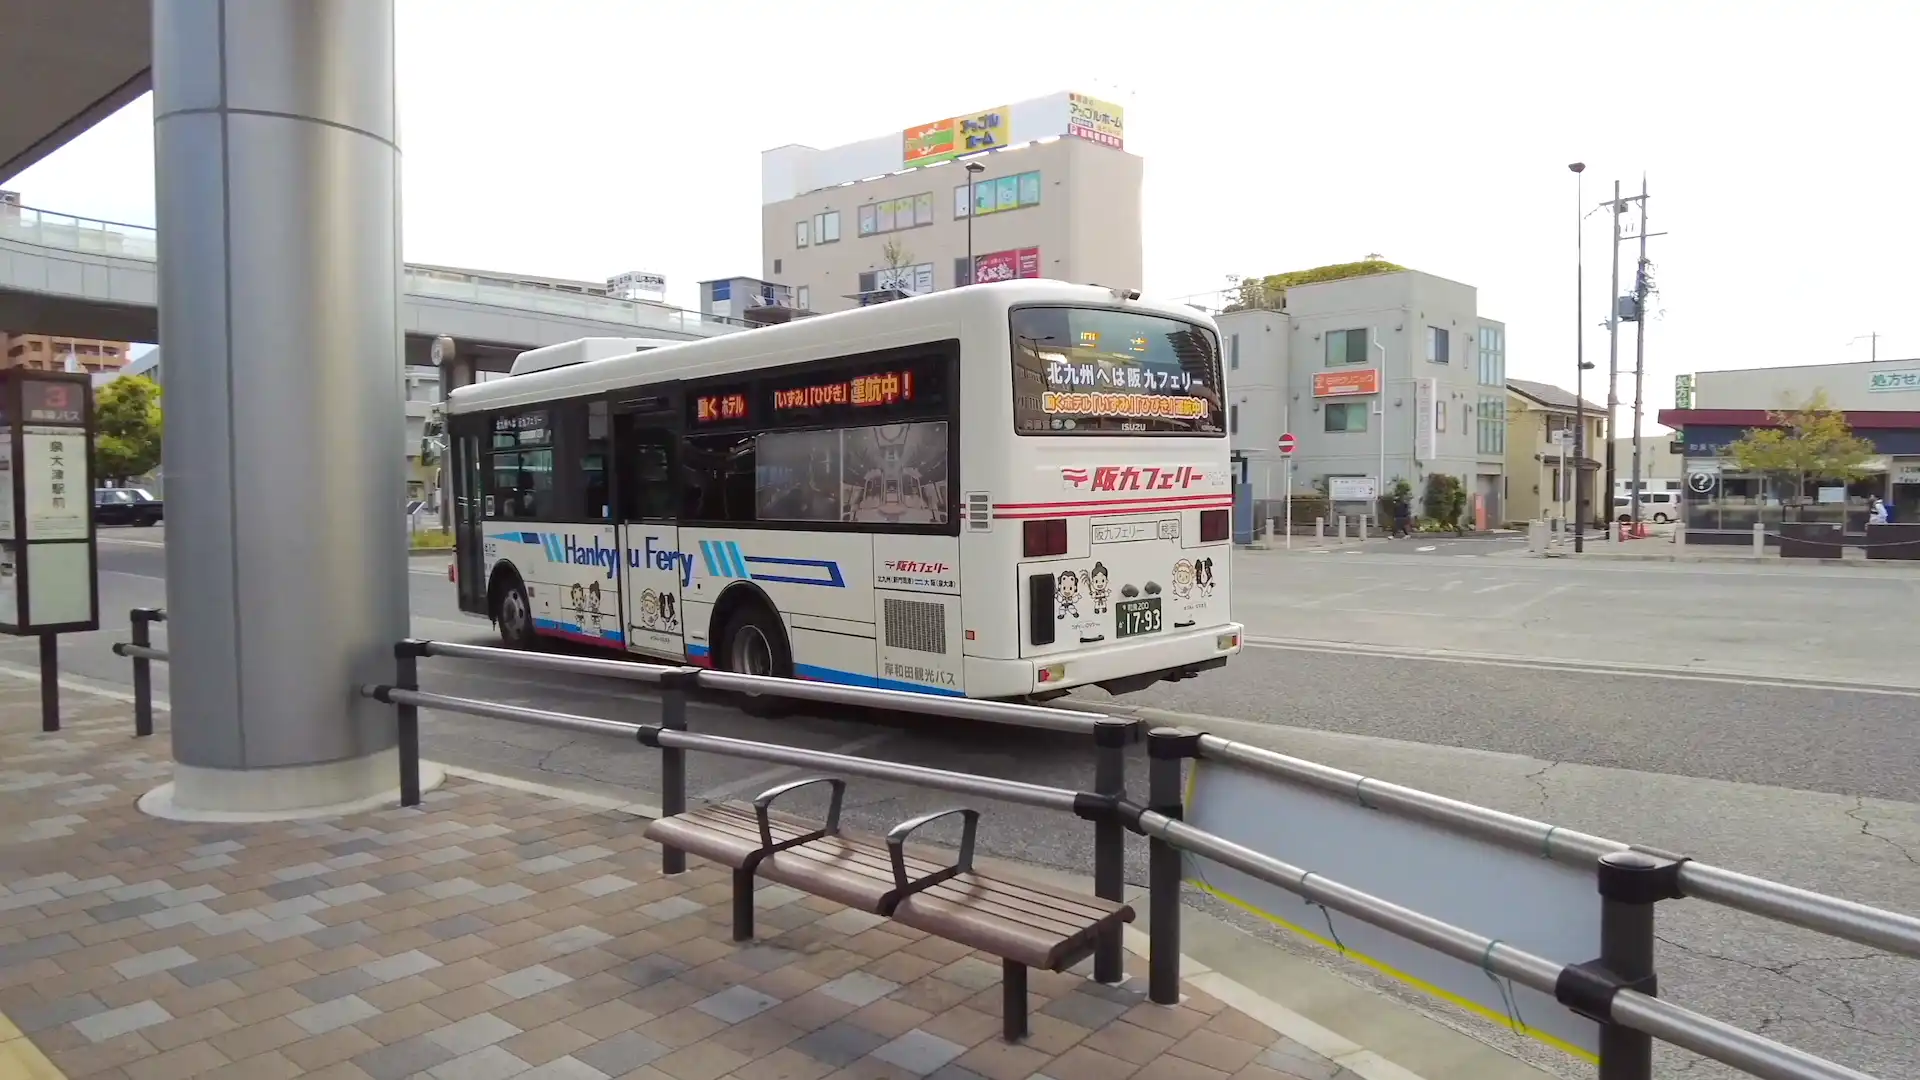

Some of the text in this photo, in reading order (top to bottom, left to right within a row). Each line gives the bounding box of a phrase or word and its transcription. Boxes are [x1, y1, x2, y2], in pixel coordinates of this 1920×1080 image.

[1047, 362, 1203, 391] 北九州へは阪九フェリー
[1871, 373, 1920, 388] 処方せ
[1121, 423, 1146, 431] ISUZU
[1091, 466, 1203, 492] 阪九フェリー
[1095, 525, 1145, 541] 阪九フェリー
[896, 560, 949, 574] 阪九フェリー
[884, 662, 956, 686] 岸和田観光バス
